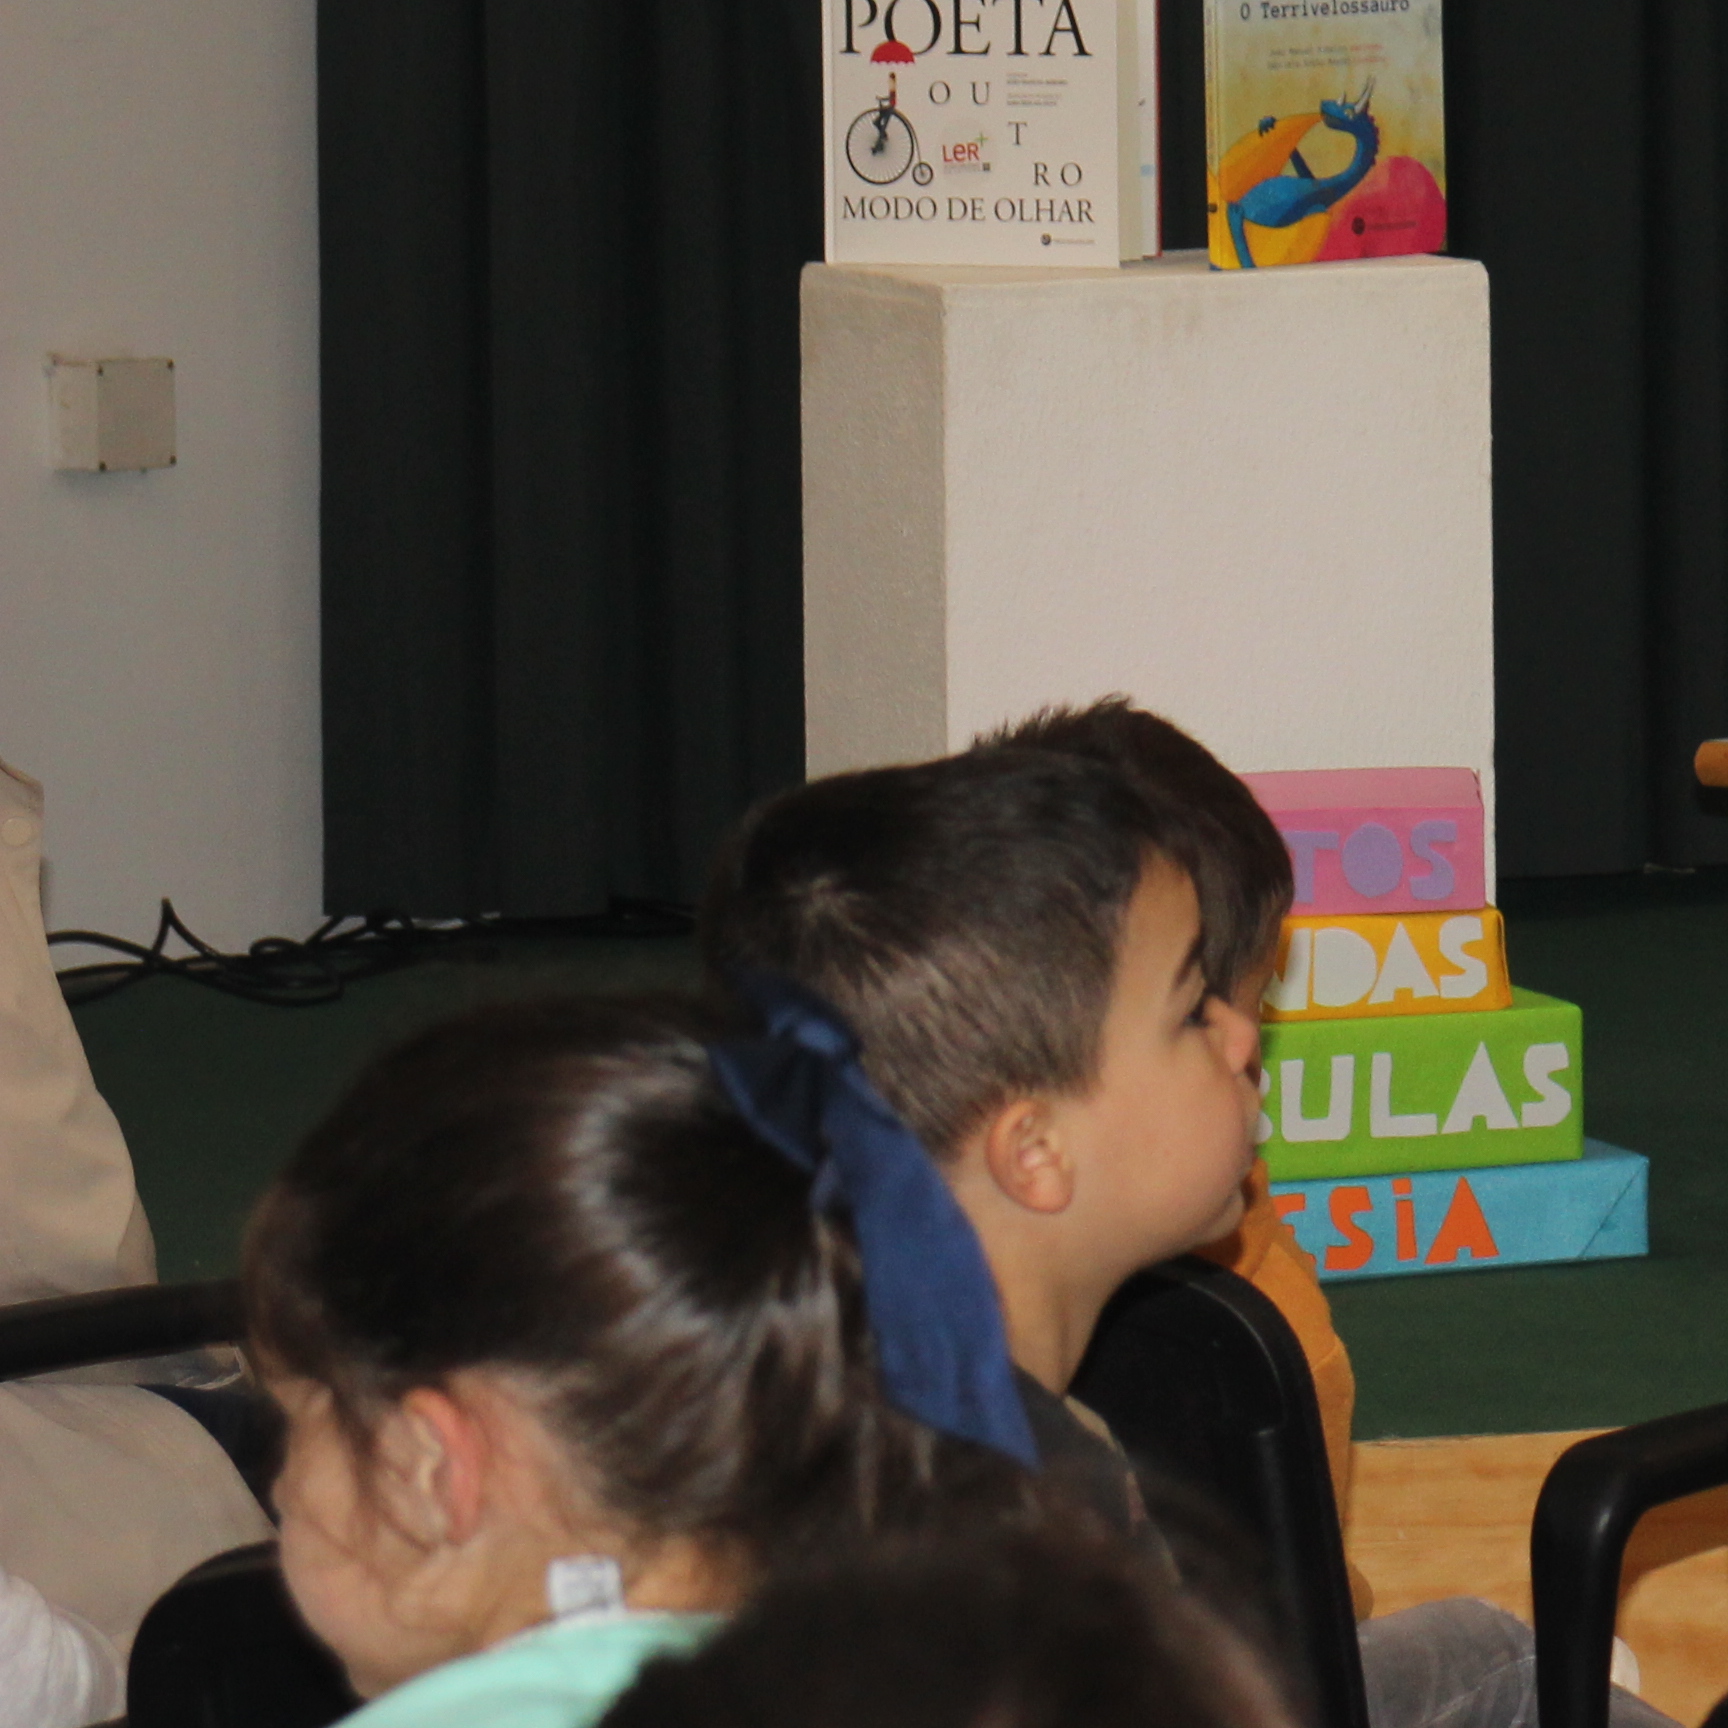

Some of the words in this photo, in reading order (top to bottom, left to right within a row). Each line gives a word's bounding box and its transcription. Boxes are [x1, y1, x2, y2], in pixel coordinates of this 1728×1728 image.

[1240, 2, 1251, 20] O
[843, 196, 937, 220] MODO
[947, 197, 985, 221] DE
[994, 197, 1095, 222] OLHAR
[1257, 1041, 1572, 1143] ULAS
